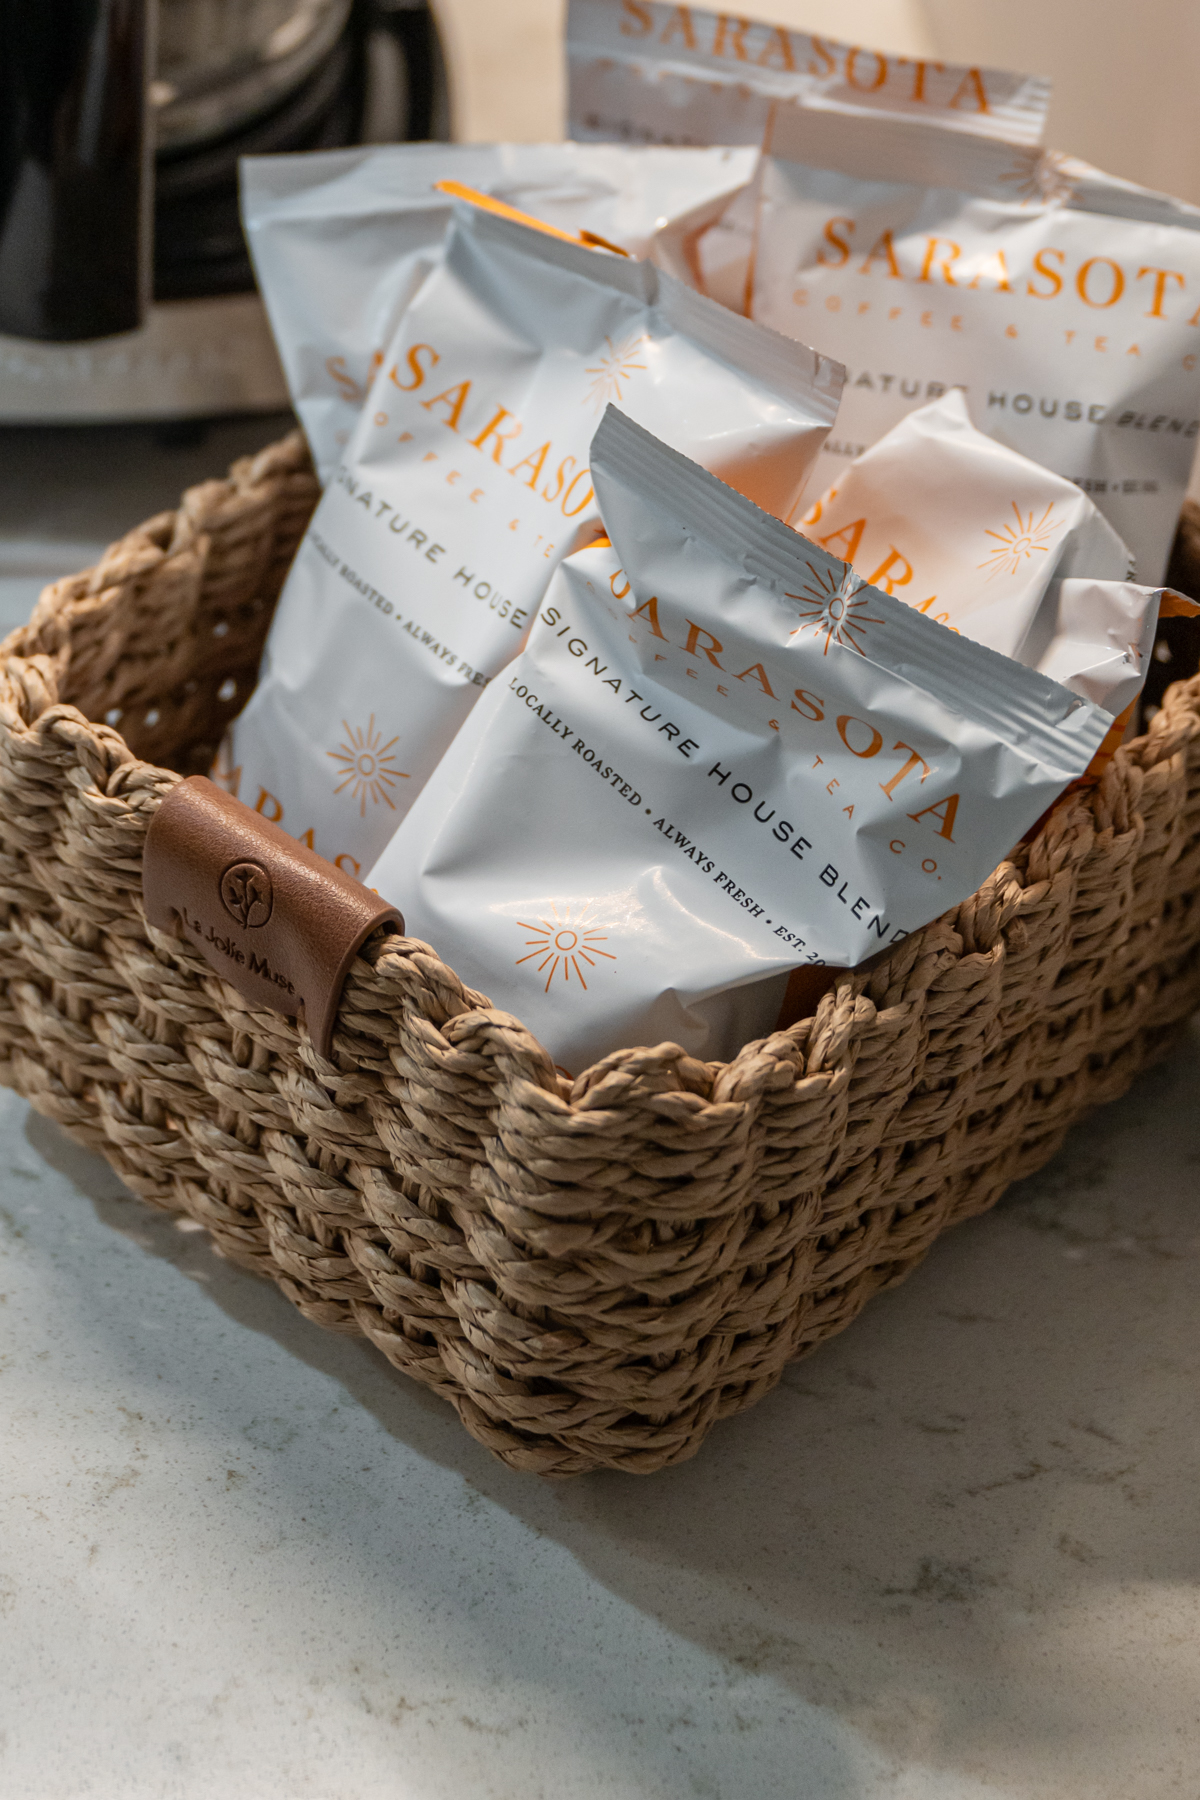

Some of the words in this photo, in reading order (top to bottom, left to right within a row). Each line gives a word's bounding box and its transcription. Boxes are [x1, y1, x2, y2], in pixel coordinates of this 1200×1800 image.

[792, 289, 964, 332] COFFEE
[1064, 330, 1141, 357] TEA
[987, 390, 1107, 424] HOUSE
[339, 564, 395, 616] ROASTED
[402, 620, 459, 667] ALWAYS
[453, 566, 528, 630] HOUSE
[541, 606, 700, 758] SIGNATURE
[707, 762, 813, 860] HOUSE
[507, 677, 574, 741] LOCALLY
[572, 738, 642, 807] ROASTED
[653, 817, 716, 874] ALWAYS
[713, 871, 766, 919] FRESH
[773, 925, 806, 953] EST.
[812, 754, 856, 820] TEA
[888, 839, 942, 881] CO.
[205, 926, 246, 965] Jolie
[248, 951, 297, 997] Muse
